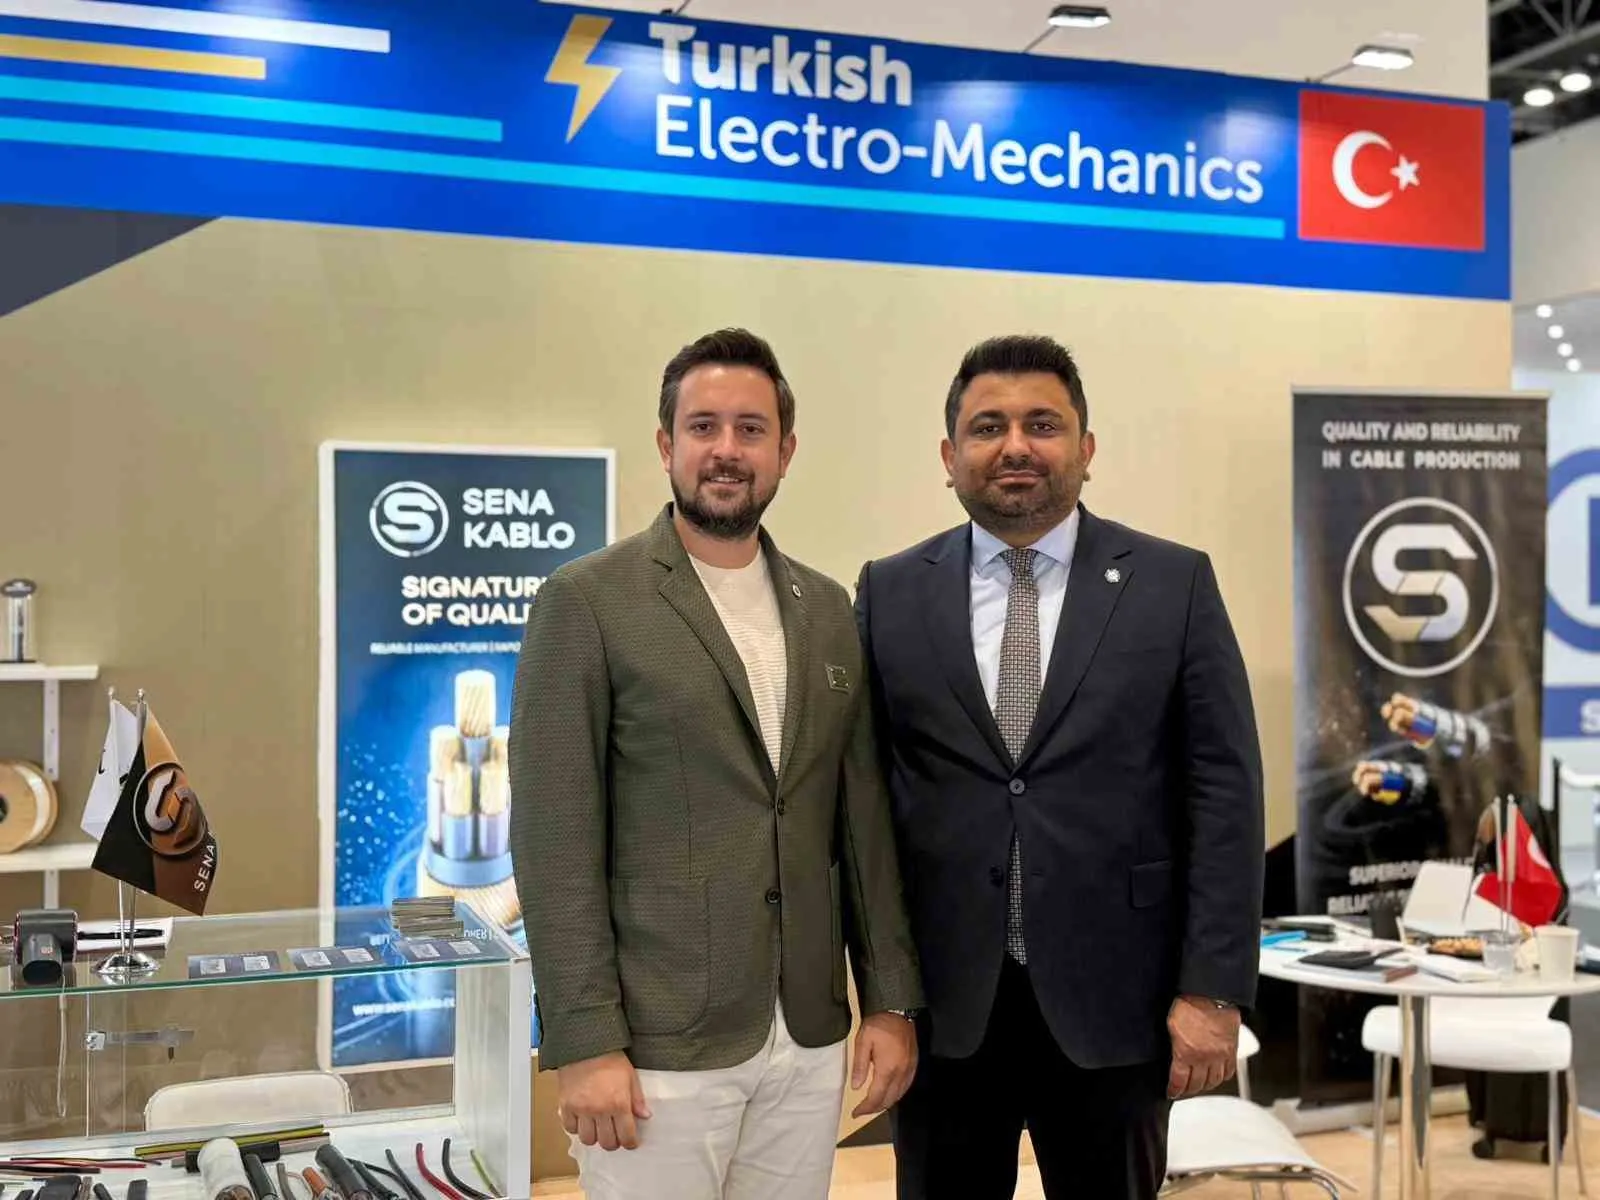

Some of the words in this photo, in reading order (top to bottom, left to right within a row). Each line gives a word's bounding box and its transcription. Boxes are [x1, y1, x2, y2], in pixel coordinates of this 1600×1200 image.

[649, 22, 913, 107] Turkish
[655, 93, 1266, 204] Electro-Mechanics
[1322, 421, 1391, 443] QUALITY
[1392, 422, 1429, 441] AND
[1430, 422, 1521, 442] RELIABILITY
[1322, 450, 1342, 468] IN
[1350, 450, 1406, 469] CABLE
[1413, 450, 1521, 470] PRODUCTION
[462, 487, 555, 516] SENA
[463, 521, 576, 550] KABLO
[401, 575, 547, 599] SIGNATUR
[401, 602, 443, 626] OF
[446, 602, 532, 627] QUALI
[194, 845, 216, 892] SENA
